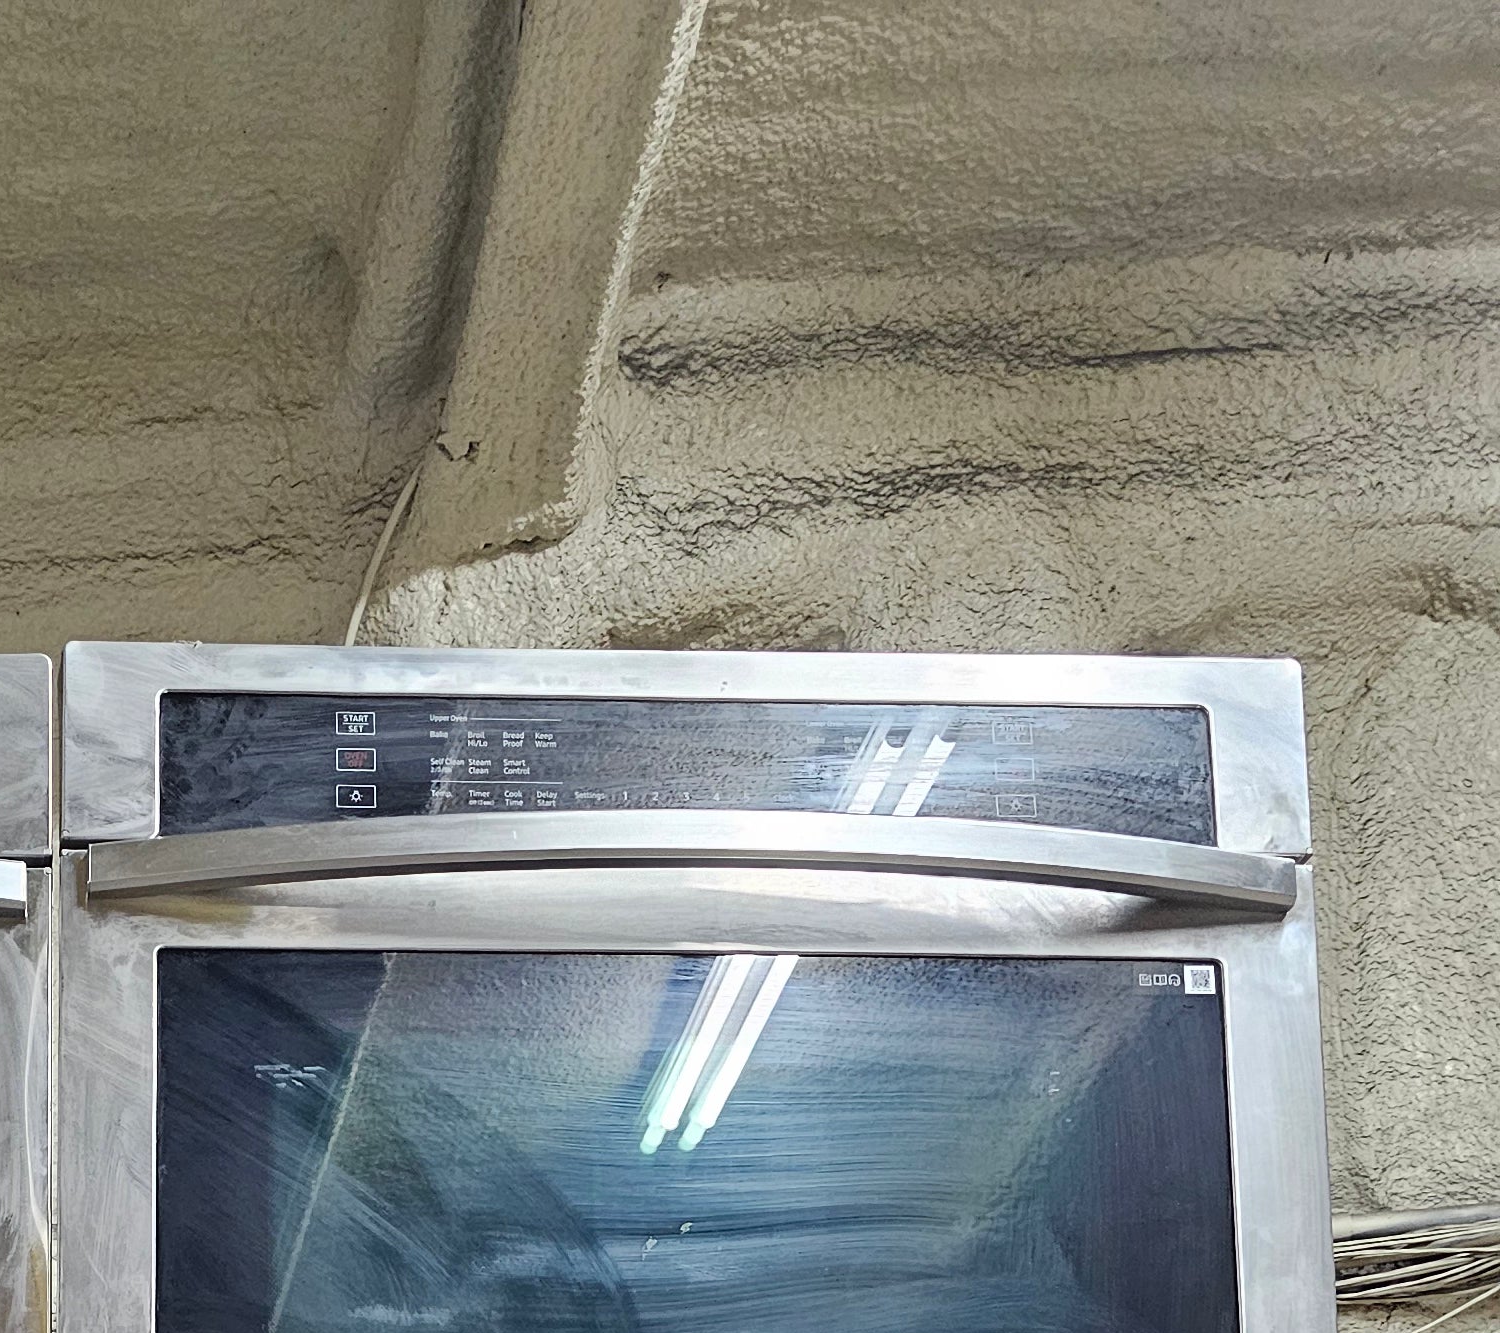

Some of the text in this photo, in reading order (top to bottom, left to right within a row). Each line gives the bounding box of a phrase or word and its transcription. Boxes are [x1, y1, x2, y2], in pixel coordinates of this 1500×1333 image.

[342, 714, 369, 722] START
[429, 714, 468, 722] Upper Oven
[348, 725, 364, 733] SET
[467, 731, 485, 739] Broil
[502, 731, 525, 739] Bread
[535, 732, 553, 740] Keep
[503, 740, 523, 748] Proof
[535, 740, 557, 748] Warm
[344, 752, 368, 760] OVEN
[430, 758, 465, 766] Self Clean
[468, 758, 492, 766] Steam
[503, 759, 526, 767] Smart
[468, 767, 489, 775] Clean
[503, 767, 530, 775] Control
[469, 790, 490, 798] Timer
[504, 790, 523, 798] Cook
[536, 790, 558, 799] Delay
[574, 791, 605, 801] Settings
[622, 792, 628, 801] 1
[652, 792, 659, 801] 2
[683, 792, 690, 801] 3
[712, 792, 720, 801] 4
[537, 799, 556, 807] Start
